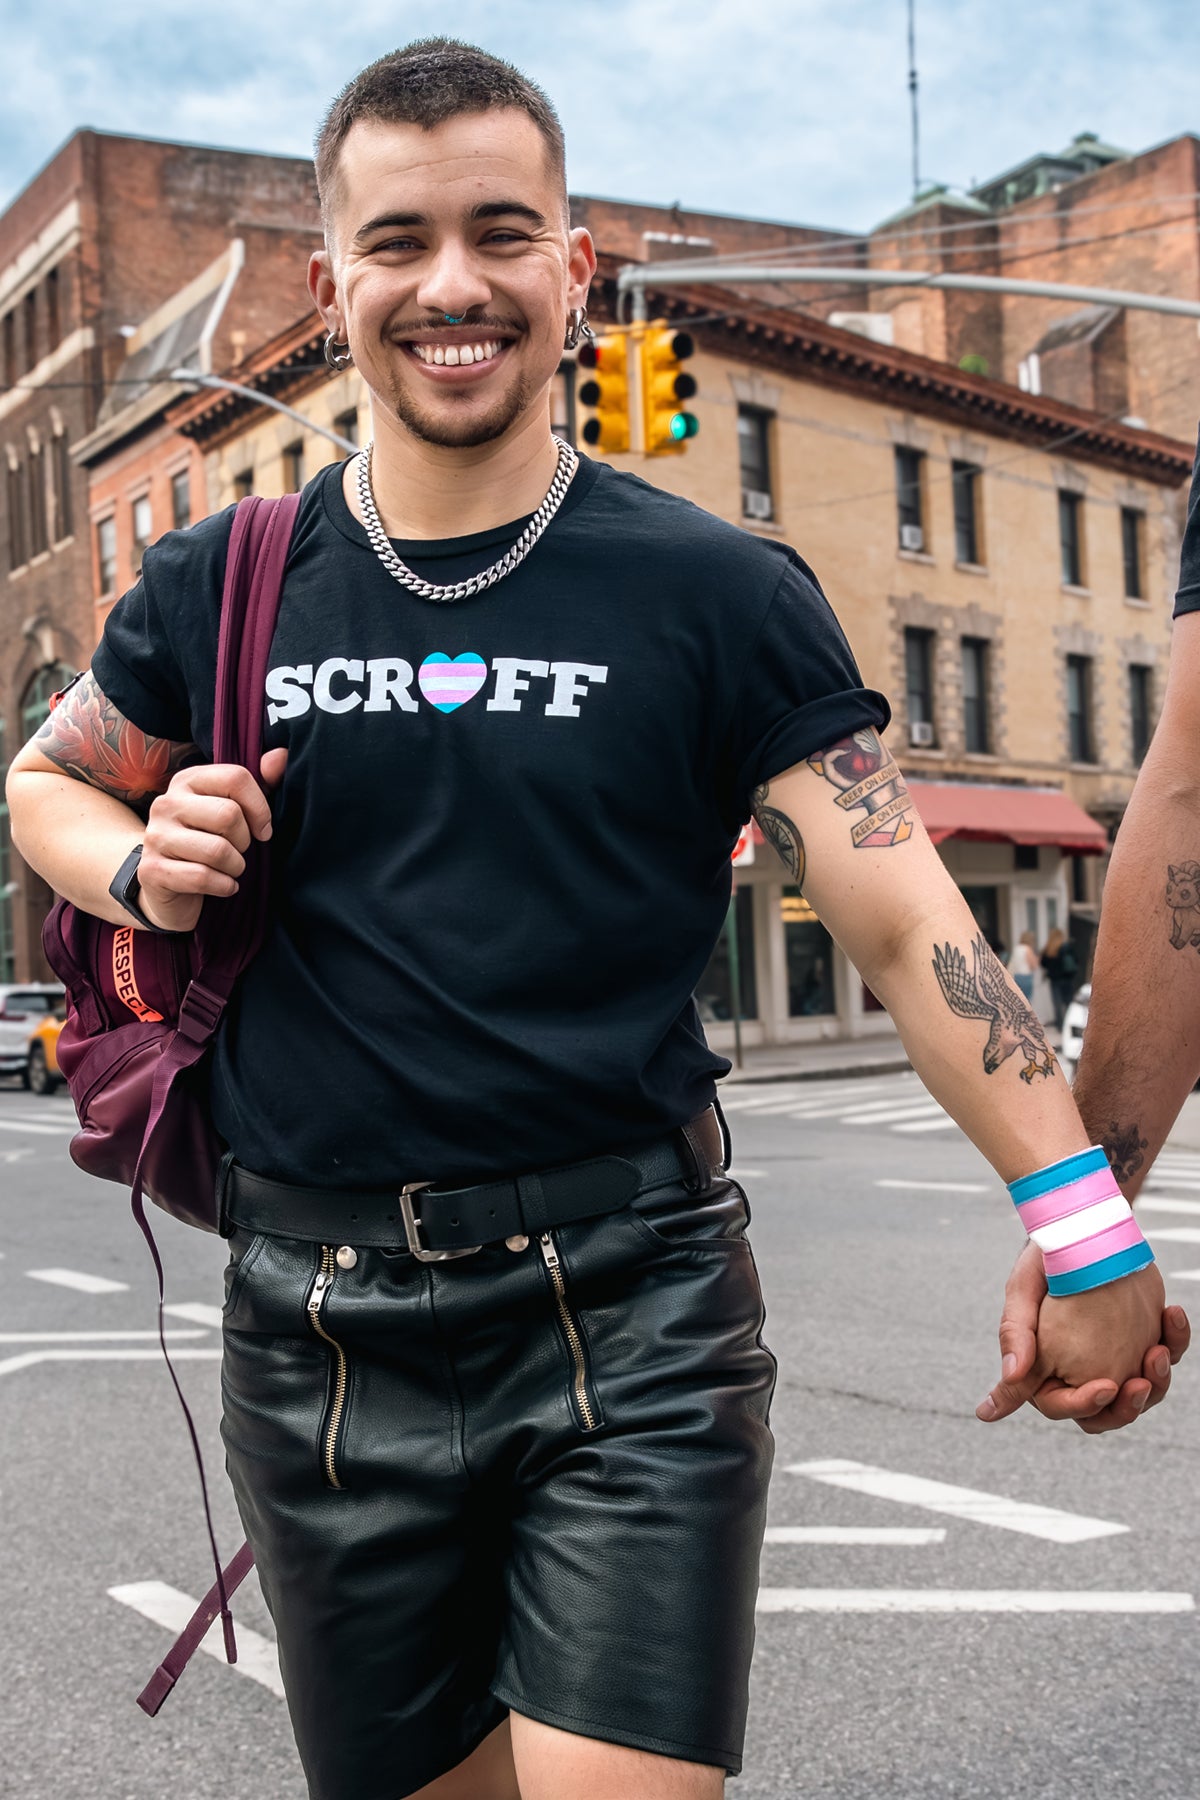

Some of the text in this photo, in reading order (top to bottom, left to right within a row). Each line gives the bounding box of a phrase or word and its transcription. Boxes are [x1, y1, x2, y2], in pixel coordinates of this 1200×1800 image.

[841, 787, 864, 806] KEEP
[865, 779, 879, 790] ON
[854, 817, 876, 838] KEEP
[876, 810, 890, 822] ON
[116, 929, 155, 1016] RESPECT
